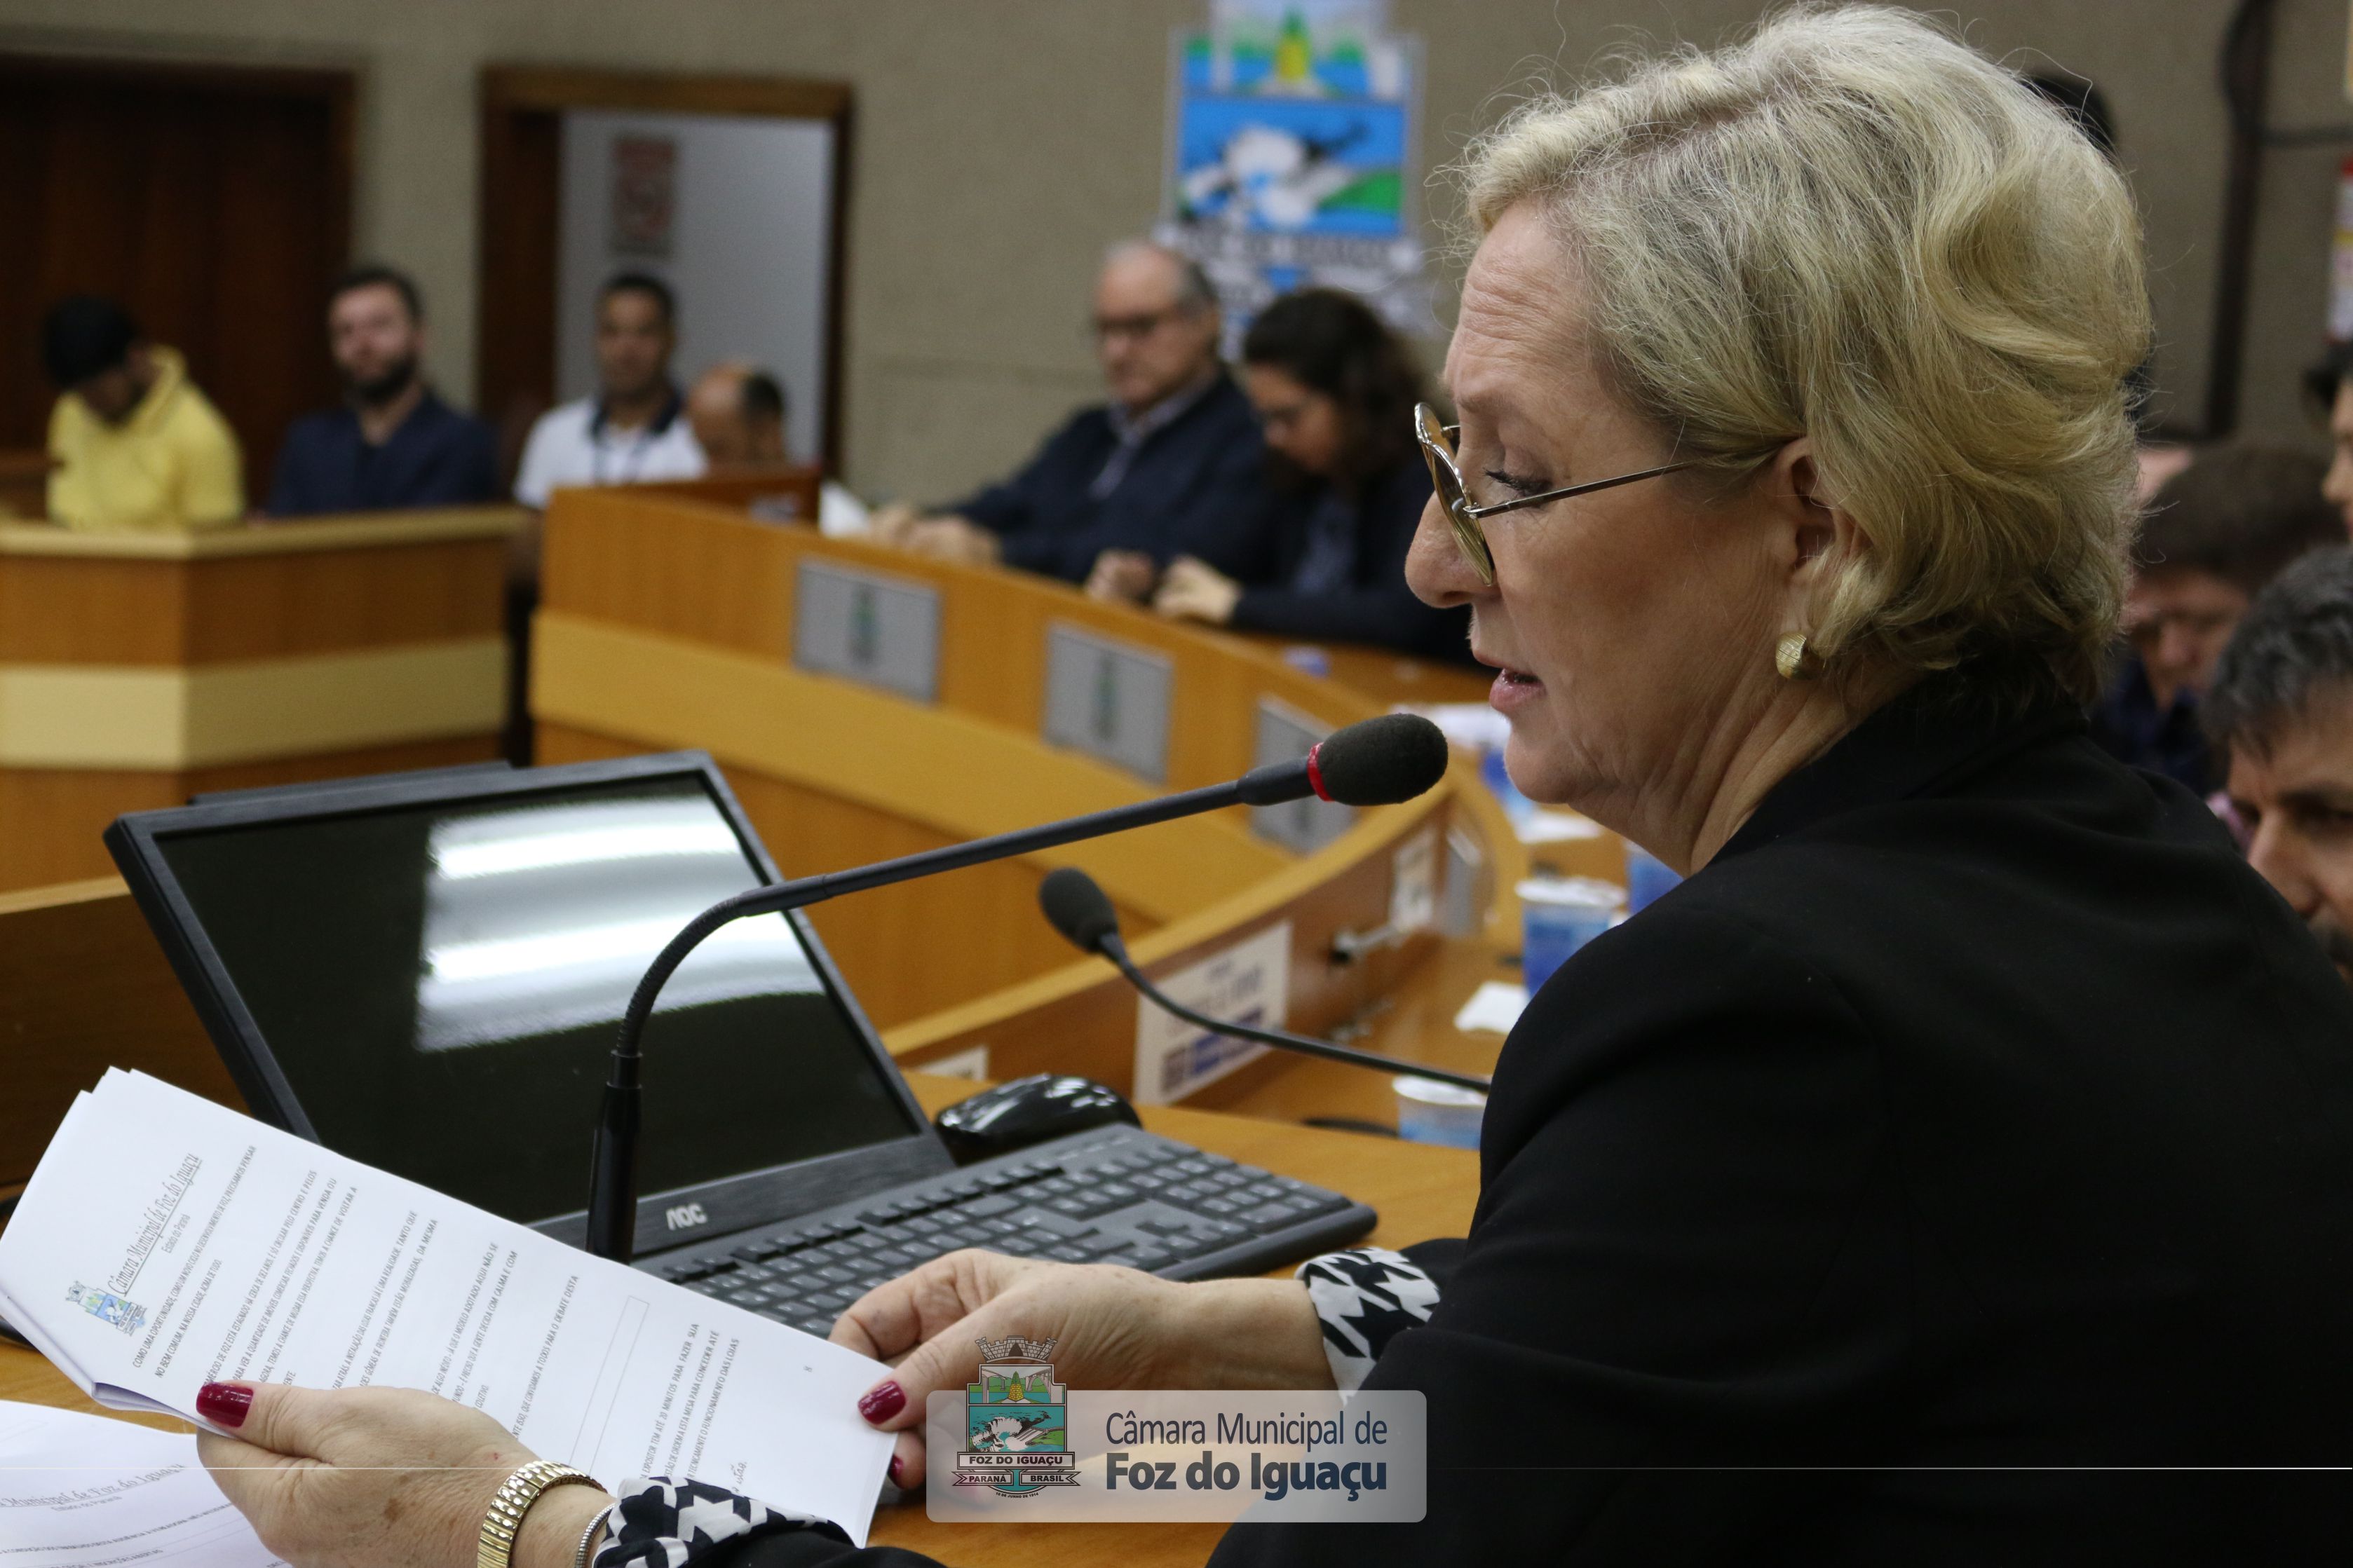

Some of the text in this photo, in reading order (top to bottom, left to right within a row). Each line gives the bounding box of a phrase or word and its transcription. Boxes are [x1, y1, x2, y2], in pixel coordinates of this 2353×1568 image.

[240, 1146, 256, 1168] PENSAR
[170, 1154, 202, 1187] Iguaçu
[224, 1166, 245, 1197] PRECISAMOS
[303, 1170, 317, 1189] PELOS
[163, 1182, 182, 1197] do
[155, 1194, 176, 1213] Foz
[219, 1196, 231, 1206] FOZ,
[290, 1194, 305, 1215] CENTRO
[339, 1193, 354, 1216] VOLTAR
[144, 1207, 167, 1222] de
[283, 1215, 295, 1228] PELO
[334, 1217, 342, 1226] DE
[406, 1211, 417, 1225] QUE
[665, 1203, 707, 1232] AOC
[127, 1213, 168, 1262] Municipal
[197, 1211, 222, 1248] DESENVOLVIMENTO
[274, 1228, 288, 1248] CIRCULAR
[325, 1226, 339, 1246] CHANCE
[396, 1226, 410, 1246] TANTO
[161, 1236, 178, 1253] Estado
[270, 1246, 279, 1255] SÓ
[489, 1243, 498, 1252] SE
[188, 1252, 200, 1264] CICLO
[210, 1260, 222, 1272] TUDO.
[314, 1250, 327, 1267] TEMOS
[483, 1253, 494, 1268] NÃO
[108, 1258, 139, 1296] Câmara
[182, 1263, 194, 1276] NOVO
[258, 1269, 268, 1279] DEZ
[475, 1268, 487, 1285] AQUI
[178, 1274, 187, 1283] UM
[200, 1277, 212, 1292] ACIMA
[233, 1178, 337, 1380] PARA VER QUANTIDADE DE IMÓVEIS COMERCIAIS FECHADOS DISPONÍVEIS PARA VENDA OU
[377, 1276, 388, 1288] UMA
[170, 1282, 183, 1297] COMO
[249, 1284, 260, 1298] CERCA
[297, 1292, 307, 1303] ESSA
[364, 1356, 378, 1375] GÊMEAS
[376, 1327, 391, 1349] FRONTEIRA
[385, 1307, 398, 1326] TAMBÉM
[393, 1293, 405, 1308] ESTÃO
[400, 1257, 422, 1293] MOBILIZADAS,
[416, 1246, 426, 1255] DA
[421, 1220, 438, 1244] MESMA
[191, 1291, 206, 1308] CIDADE,
[365, 1296, 379, 1315] FRANCAS
[464, 1285, 480, 1313] ADOTADO
[150, 1296, 177, 1335] OPORTUNIDADE,
[182, 1307, 196, 1324] NOSSA
[232, 1304, 250, 1331] ESTAGNADO
[289, 1302, 302, 1319] MUDAR
[461, 1251, 517, 1379] PRECISO QUE GENTE DECIDA COM CALMA COM
[179, 1323, 188, 1332] NA
[286, 1318, 294, 1326] DE
[361, 1314, 372, 1328] LOJAS
[454, 1313, 469, 1335] MODELO
[226, 1330, 237, 1344] ESTÁ
[278, 1325, 292, 1343] CHANCE
[357, 1325, 366, 1335] DAS
[688, 1324, 699, 1337] SUA
[708, 1331, 719, 1346] ATÉ
[142, 1335, 155, 1349] UMA
[167, 1332, 184, 1354] COMUM.
[221, 1342, 231, 1354] FOZ
[346, 1334, 362, 1361] INSTALAÇÃO
[449, 1337, 459, 1348] QUE
[133, 1348, 147, 1368] COMO
[217, 1353, 226, 1361] DE
[267, 1347, 280, 1364] TEMOS
[516, 1276, 578, 1426] ISSO, QUE CONVIDAMOS TODOS PARA DEBATE DESTA
[679, 1342, 692, 1362] FAZER
[160, 1354, 172, 1368] BEM
[440, 1356, 452, 1374] INÉDITO
[696, 1347, 714, 1382] CONCEDER
[155, 1367, 165, 1377] NO
[259, 1365, 275, 1382] AGORA,
[435, 1373, 445, 1387] ALGO
[672, 1365, 684, 1382] PARA
[432, 1386, 440, 1394] DE
[475, 1385, 489, 1408] COLETIVO.
[662, 1384, 677, 1411] MINUTOS
[689, 1383, 700, 1399] PARA
[684, 1400, 695, 1417] MESA
[689, 1435, 706, 1473] TECNICAMENTE
[702, 1377, 725, 1430] FUNCIONAMENTO
[720, 1361, 731, 1376] DAS
[726, 1339, 739, 1361] LOJAS
[659, 1412, 667, 1420] 20
[679, 1417, 689, 1431] ESTA
[656, 1420, 665, 1432] ATÉ
[651, 1433, 660, 1445] TEM
[672, 1435, 683, 1454] ORDEM
[642, 1445, 656, 1473] EXPOSITOR
